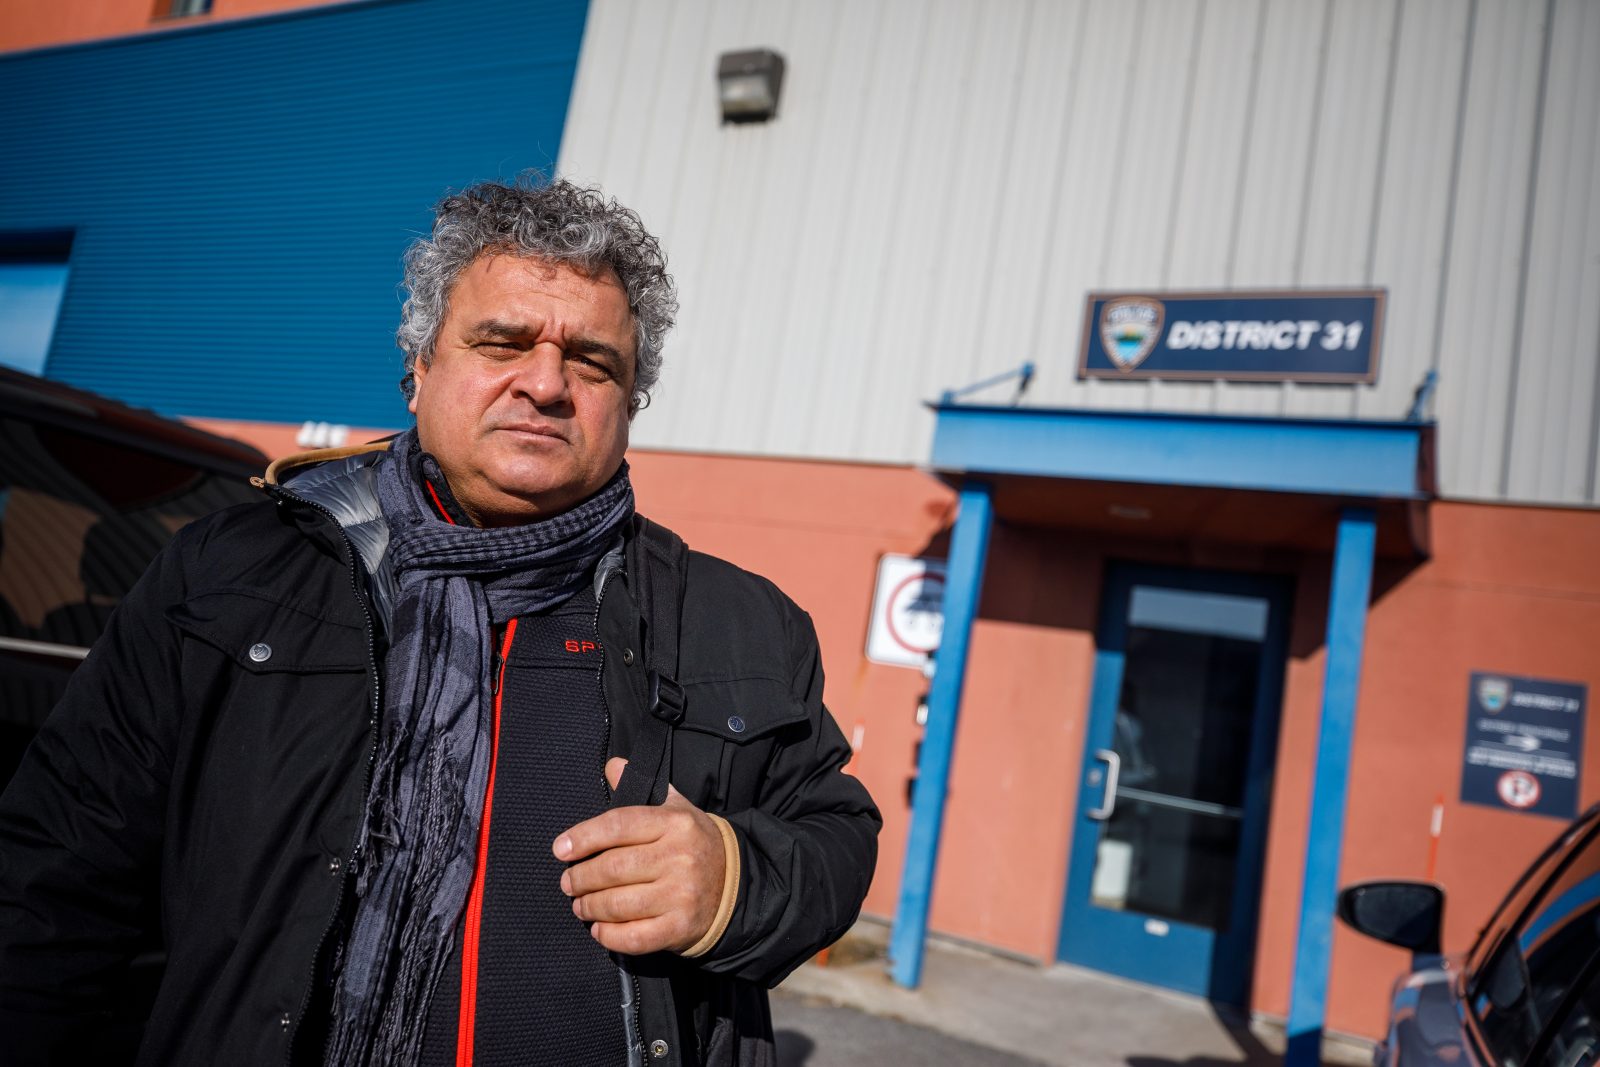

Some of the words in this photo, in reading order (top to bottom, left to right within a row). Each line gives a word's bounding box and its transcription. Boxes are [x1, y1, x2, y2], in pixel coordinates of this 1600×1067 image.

[1166, 320, 1321, 350] DISTRICT
[1320, 320, 1363, 350] 31
[564, 639, 600, 653] SP
